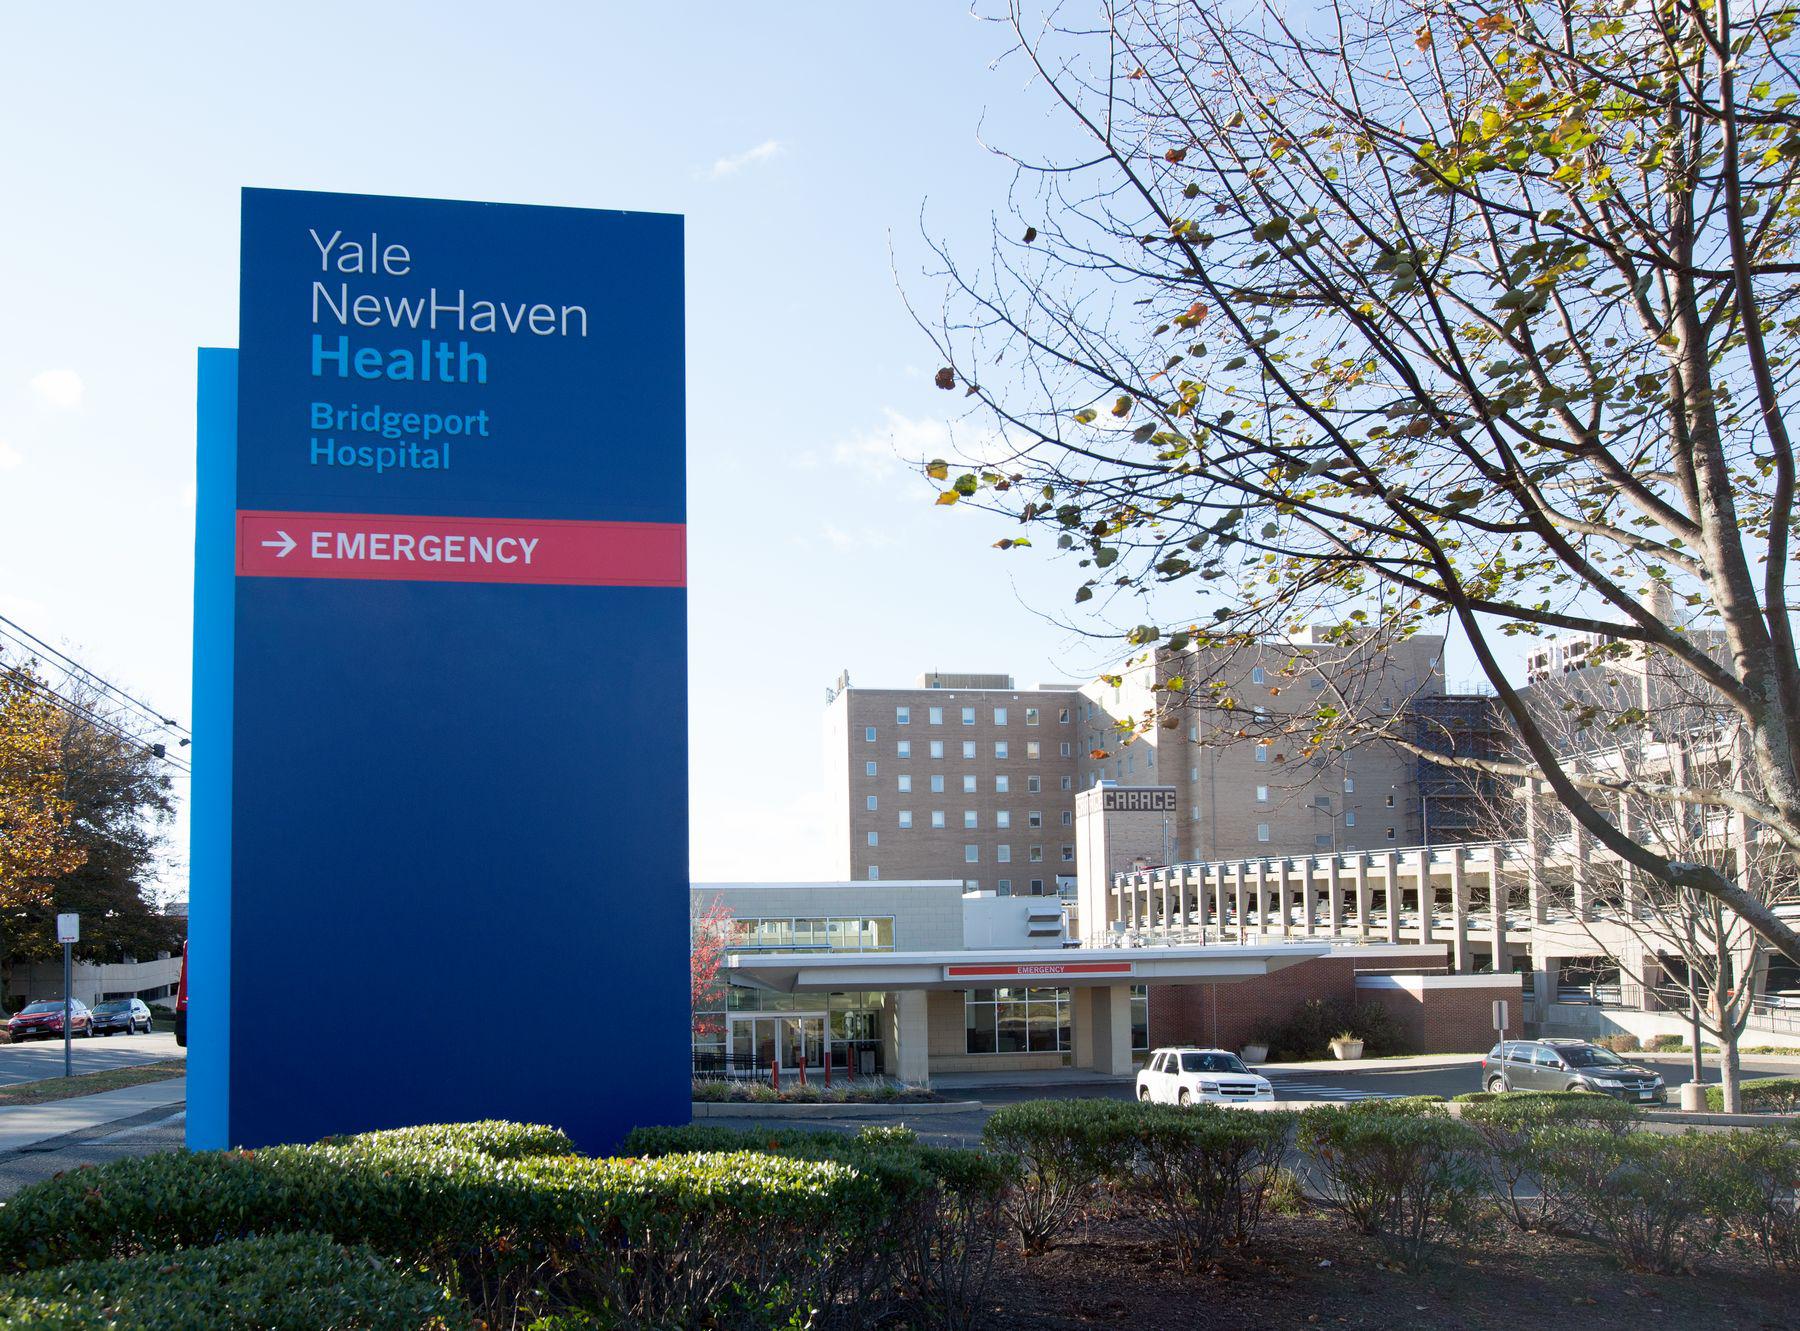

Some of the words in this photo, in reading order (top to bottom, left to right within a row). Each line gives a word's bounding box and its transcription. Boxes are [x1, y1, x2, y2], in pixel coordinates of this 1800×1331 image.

[309, 228, 411, 275] Yale
[311, 334, 488, 383] Health
[310, 402, 490, 440] Bridgeport
[310, 438, 450, 473] Hospital
[311, 531, 539, 564] EMERGENCY
[1103, 791, 1176, 810] GARAGE
[1017, 966, 1065, 974] EMERGENCY
